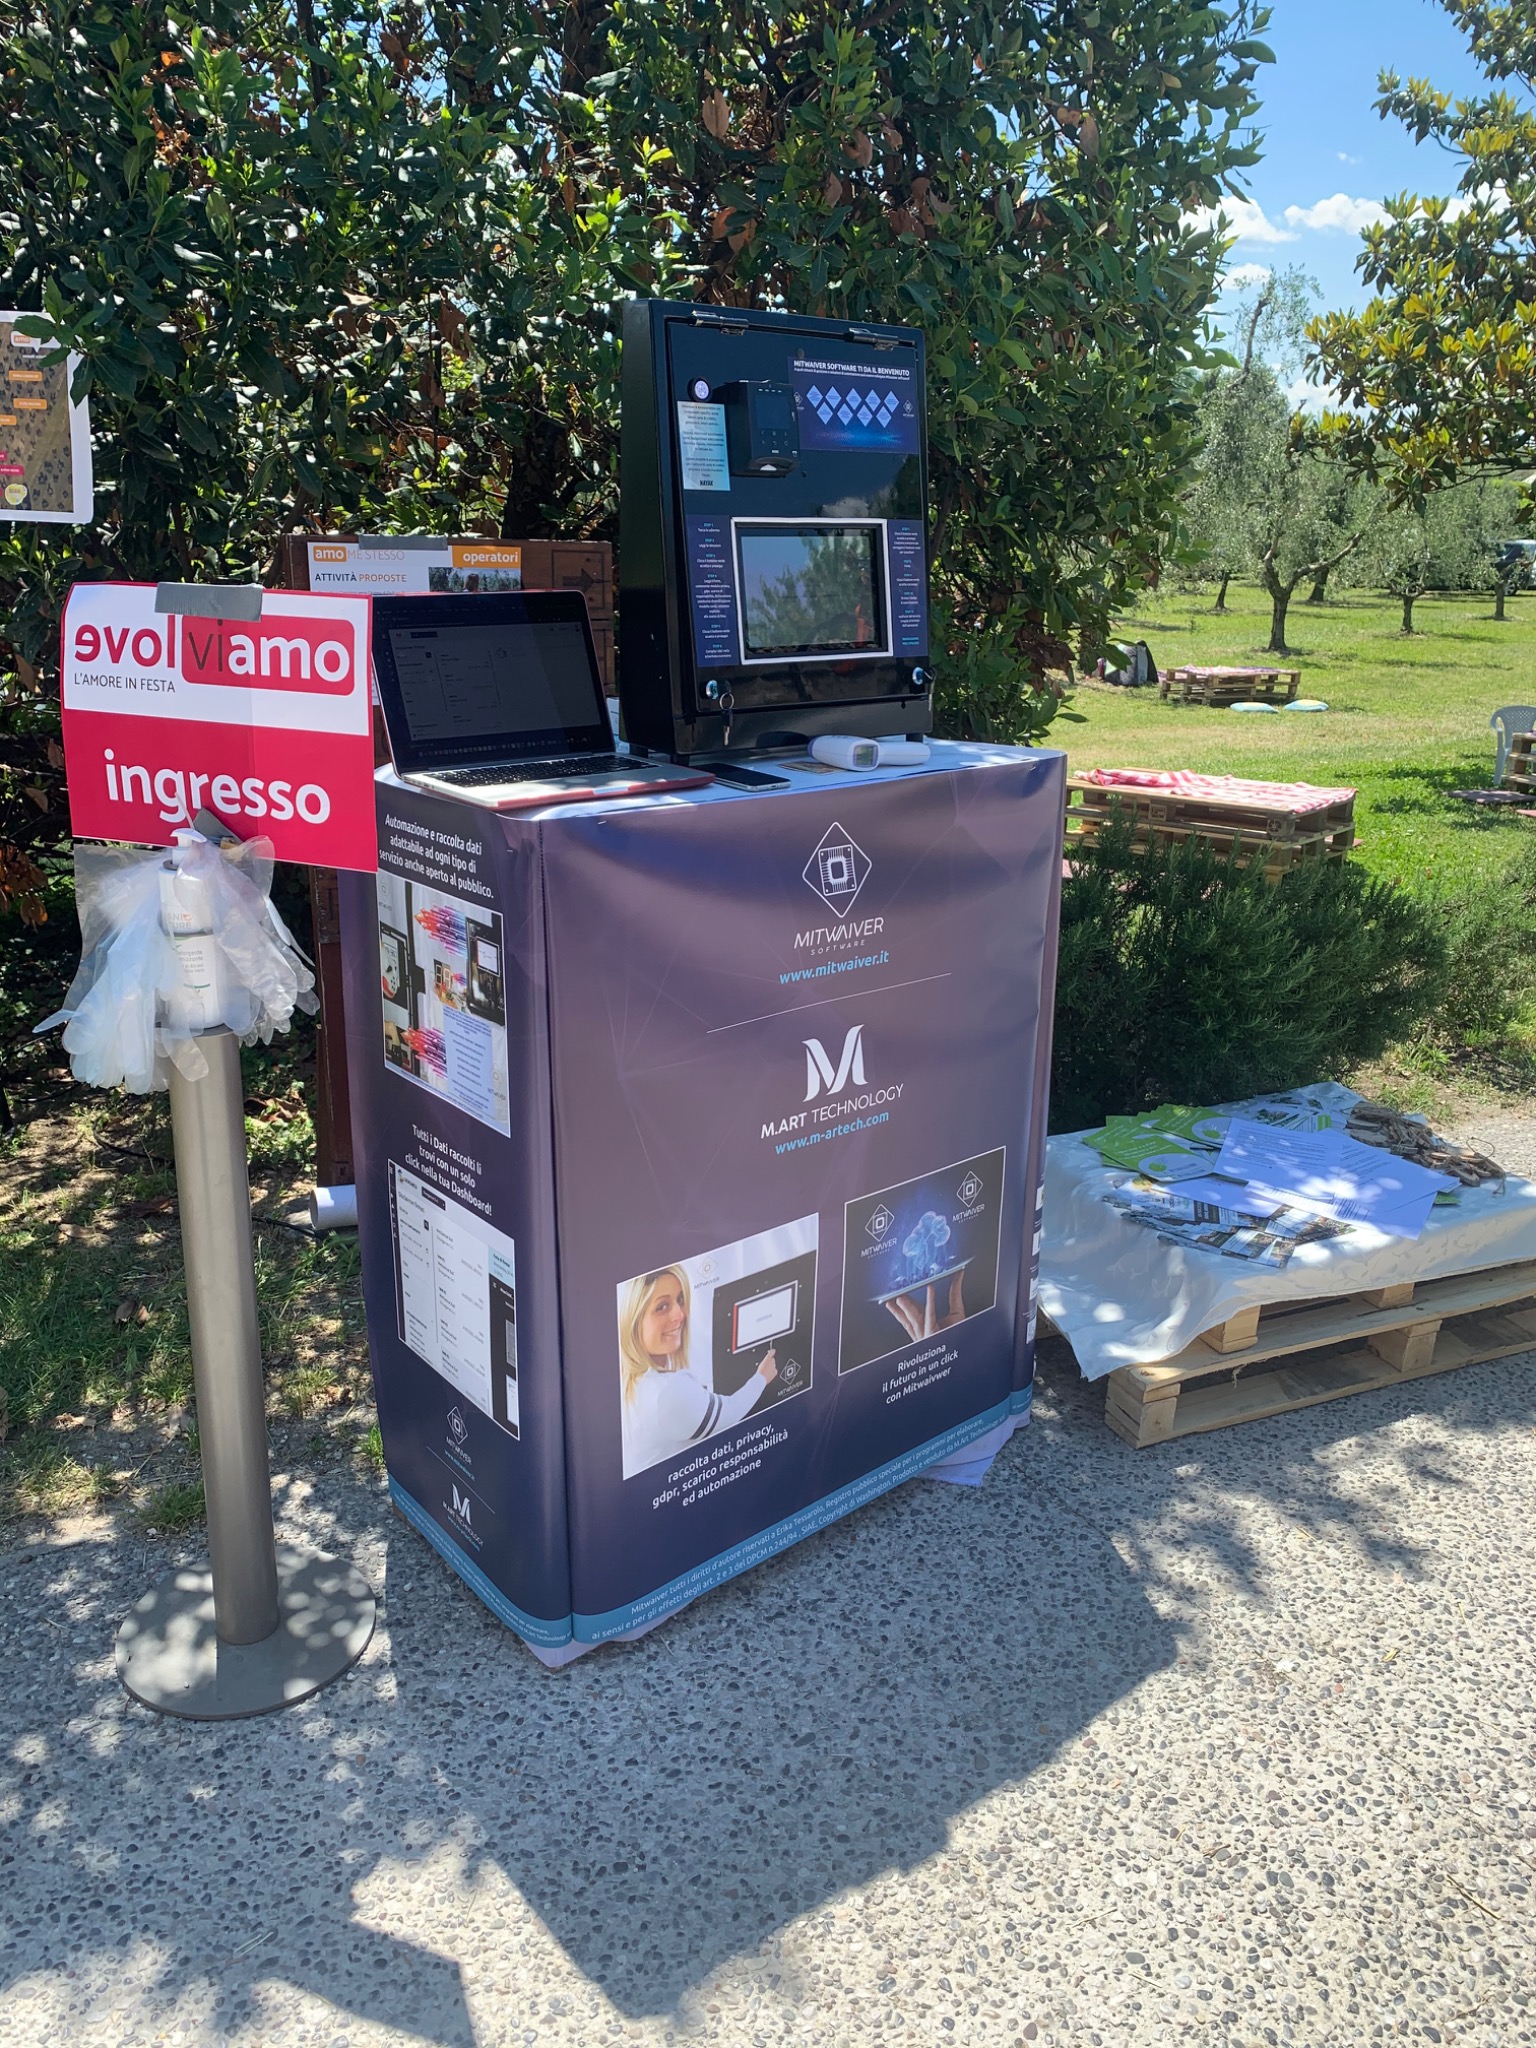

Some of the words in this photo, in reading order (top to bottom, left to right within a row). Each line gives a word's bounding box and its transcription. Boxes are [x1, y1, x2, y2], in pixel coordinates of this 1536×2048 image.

[793, 360, 827, 370] MITWAIVER
[826, 363, 857, 373] SOFTWARE
[877, 368, 910, 377] BENVENUTO
[315, 548, 344, 560] amo
[347, 549, 362, 560] ME
[365, 549, 405, 561] STESSO
[463, 551, 519, 565] operatori
[314, 571, 357, 582] ATTIVITÀ
[359, 573, 407, 583] PROPOSTE
[74, 673, 122, 689] L'AMORE
[125, 677, 137, 689] IN
[140, 679, 176, 693] FESTA
[103, 748, 331, 824] ingresso
[384, 813, 430, 839] Automazione
[430, 830, 435, 840] e
[436, 833, 464, 851] raccolta
[466, 838, 483, 856] dati
[389, 834, 424, 856] adattabile
[425, 845, 434, 859] ad
[435, 853, 451, 866] ogni
[451, 856, 467, 871] tipo
[468, 858, 477, 874] di
[378, 849, 404, 867] servizio
[404, 858, 425, 875] anche
[425, 866, 449, 883] aperto
[449, 872, 457, 887] al
[458, 877, 495, 899] pubblico.
[793, 916, 885, 950] MITWAIVER
[810, 939, 866, 956] SOFTWARE
[778, 949, 890, 985] www.mitwaiver.it
[760, 1112, 807, 1139] M.ART
[811, 1083, 904, 1124] TECHNOLOGY
[411, 1123, 429, 1143] Tutti
[429, 1133, 433, 1146] i
[433, 1136, 449, 1155] Dati
[449, 1147, 476, 1171] raccolti
[774, 1111, 890, 1155] www.m-artech.com
[404, 1152, 420, 1170] click
[421, 1164, 438, 1182] nella
[438, 1172, 450, 1190] tua
[451, 1181, 493, 1217] Dashboard!
[419, 1145, 436, 1164] trovi
[436, 1156, 449, 1173] con
[450, 1166, 459, 1179] un
[460, 1173, 476, 1188] solo
[952, 1202, 985, 1223] MITWAIVER
[860, 1236, 898, 1258] MITWAIVER
[882, 1381, 888, 1393] il
[889, 1370, 917, 1390] futuro
[918, 1366, 927, 1376] in
[928, 1360, 939, 1371] un
[940, 1349, 959, 1366] click
[897, 1344, 947, 1373] Rivoluziona
[886, 1391, 901, 1404] con
[902, 1366, 952, 1396] Mitwaivwer
[652, 1487, 680, 1510] gdpr,
[682, 1466, 717, 1492] scarico
[719, 1428, 788, 1472] responsabilità
[667, 1454, 709, 1483] raccolta
[711, 1441, 734, 1461] dati,
[736, 1423, 775, 1451] privacy,
[682, 1491, 696, 1507] ed
[697, 1458, 762, 1499] automazione
[631, 1590, 669, 1615] Mitwaiver
[669, 1578, 686, 1594] tutti
[687, 1576, 690, 1584] i
[691, 1566, 711, 1583] diritti
[711, 1550, 742, 1571] d'autore
[742, 1534, 771, 1554] riservati
[776, 1522, 793, 1536] Erika
[825, 1489, 852, 1509] Registro
[852, 1475, 878, 1495] pubblico
[878, 1461, 902, 1481] speciale
[902, 1455, 912, 1467] per
[915, 1437, 946, 1460] programmi
[946, 1433, 956, 1443] per
[591, 1631, 600, 1640] ai
[601, 1622, 624, 1638] sensi
[632, 1615, 646, 1627] per
[647, 1608, 657, 1620] gli
[658, 1593, 682, 1613] effetti
[683, 1582, 702, 1600] degli
[702, 1577, 715, 1589] art.
[716, 1573, 722, 1581] 2
[728, 1566, 734, 1575] 3
[734, 1559, 746, 1572] del
[746, 1548, 768, 1566] DPCM
[818, 1502, 849, 1525] Copyright
[849, 1498, 855, 1508] di
[892, 1464, 918, 1483] Prodotto
